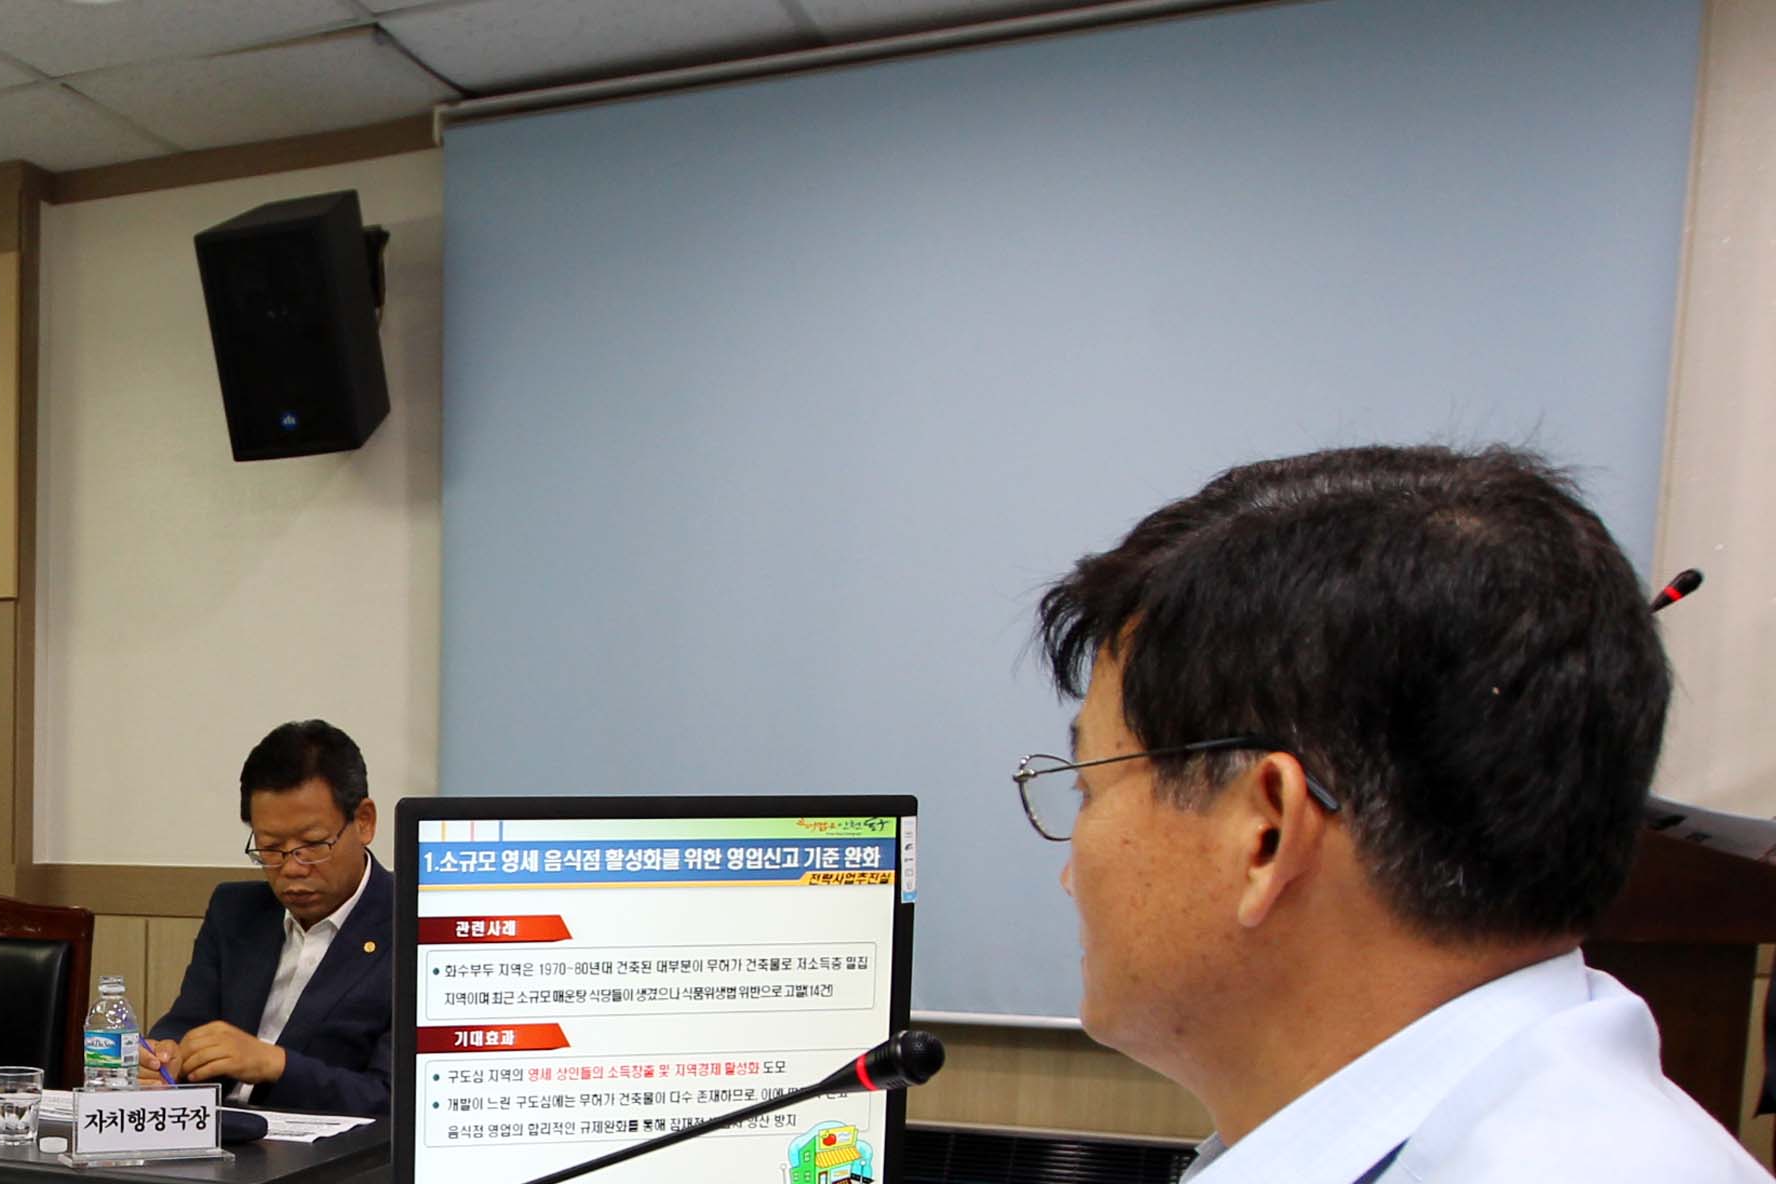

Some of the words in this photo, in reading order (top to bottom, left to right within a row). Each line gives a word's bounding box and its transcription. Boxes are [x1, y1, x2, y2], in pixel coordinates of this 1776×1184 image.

[501, 849, 539, 873] 영세
[543, 848, 601, 872] 음식점
[605, 848, 680, 871] 활성화를
[684, 847, 722, 870] 위한
[726, 846, 800, 870] 영업신고
[804, 846, 840, 869] 기준
[844, 845, 881, 869] 완화
[455, 920, 516, 937] 관련사례
[498, 962, 534, 977] 지역은
[617, 960, 652, 975] 건축된
[656, 958, 703, 974] 대부분이
[707, 958, 742, 972] 무허가
[746, 957, 792, 973] 건축물로
[796, 956, 842, 971] 저소득층
[846, 956, 868, 970] 밀집
[444, 991, 490, 1006] 지역이며
[492, 991, 515, 1005] 최근
[517, 990, 551, 1004] 소규모
[589, 988, 634, 1003] 식당들이
[636, 987, 680, 1001] 생겼으나
[682, 986, 737, 1001] 식품위생법
[739, 985, 782, 998] 위반으로
[454, 1030, 516, 1047] 기대효과
[447, 1070, 484, 1085] 구도심
[488, 1069, 524, 1083] 지역의
[528, 1067, 553, 1082] 영세
[556, 1066, 604, 1081] 상인들의
[607, 1064, 656, 1080] 소득창출
[659, 1064, 670, 1078] 및
[675, 1062, 721, 1077] 지역경제
[725, 1061, 760, 1076] 활성화
[763, 1060, 787, 1075] 도모
[447, 1097, 484, 1112] 개발이
[487, 1096, 512, 1111] 느린
[516, 1094, 576, 1110] 구도심에는
[579, 1092, 615, 1108] 무허가
[619, 1091, 665, 1107] 건축물이
[670, 1090, 693, 1104] 다수
[84, 1105, 211, 1134] 자치행정국장
[447, 1124, 484, 1140] 음식점
[488, 1122, 524, 1138] 영업의
[527, 1121, 576, 1137] 합리적인
[580, 1119, 638, 1135] 규제완화를
[642, 1117, 666, 1132] 통해
[774, 1113, 797, 1128] 방지
